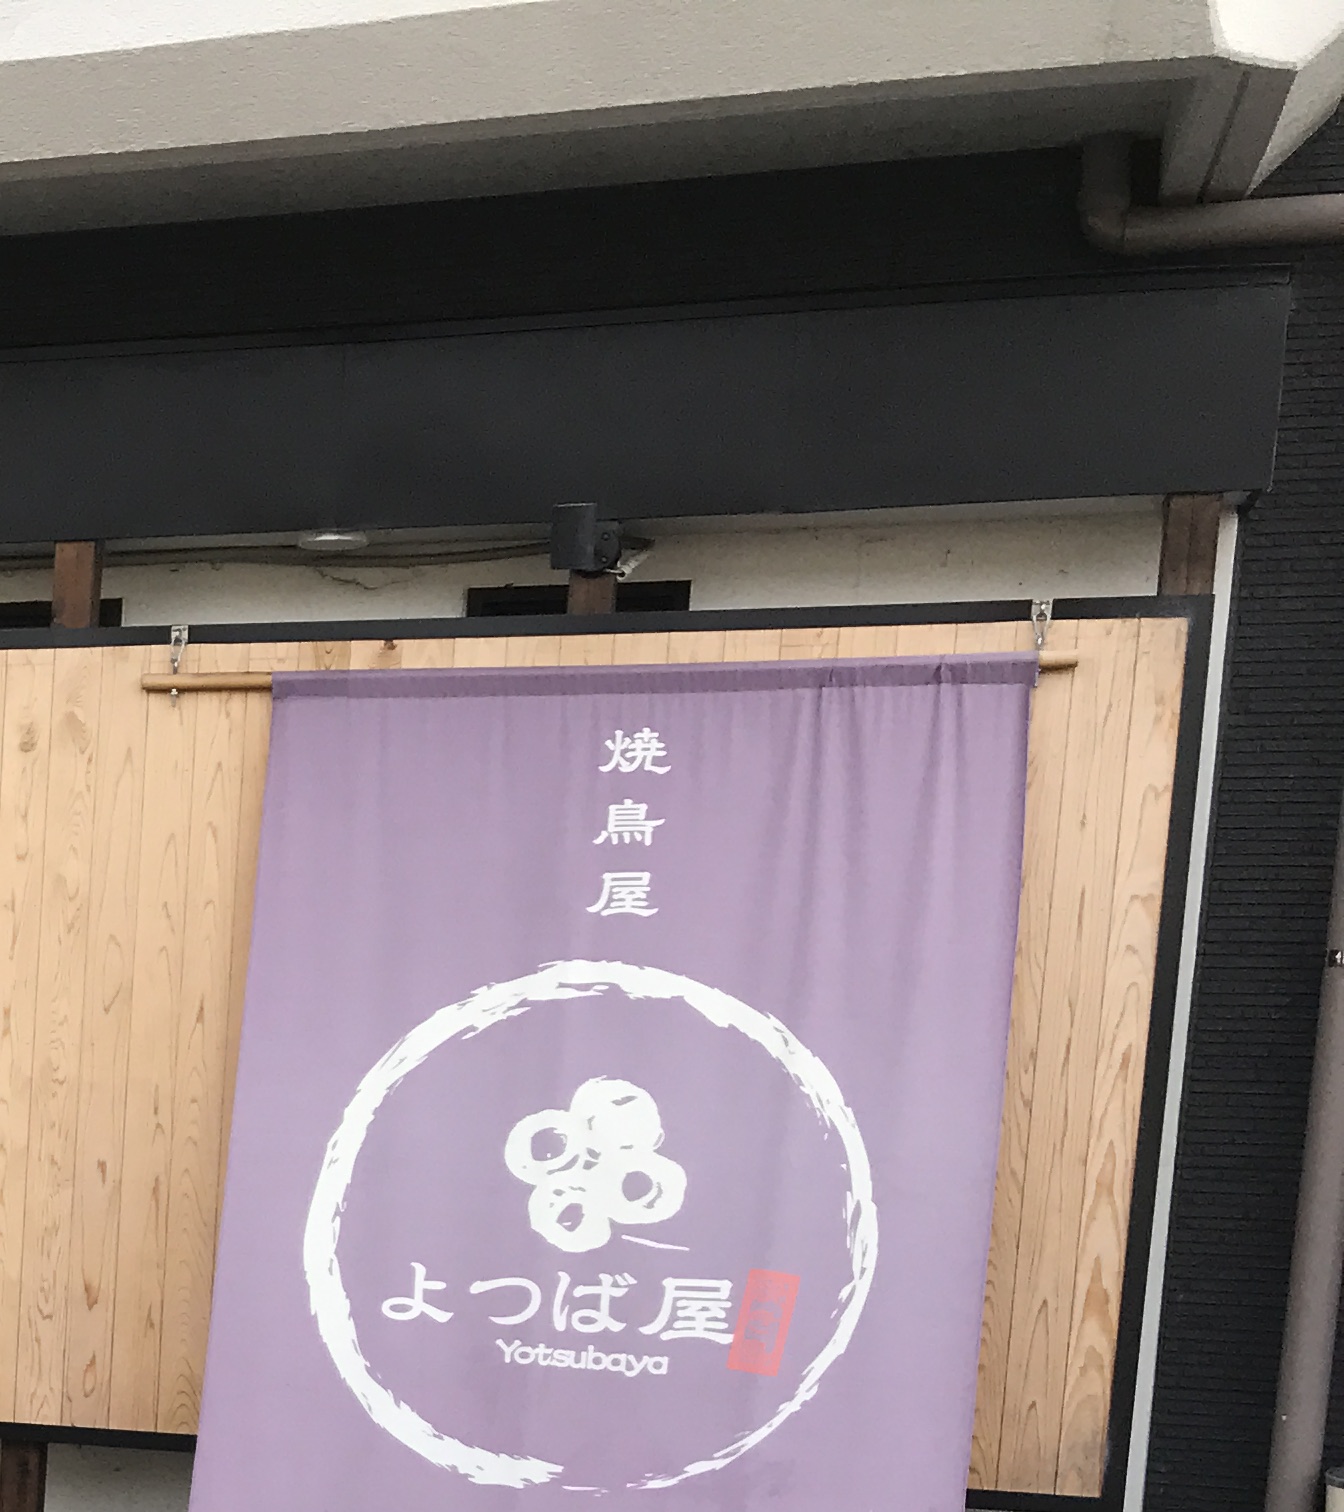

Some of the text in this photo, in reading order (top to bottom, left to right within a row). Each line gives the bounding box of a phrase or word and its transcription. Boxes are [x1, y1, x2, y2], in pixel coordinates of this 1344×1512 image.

[585, 726, 672, 917] 焼鳥屋
[381, 1262, 735, 1345] よつば屋
[495, 1338, 669, 1377] Yotsubaya
